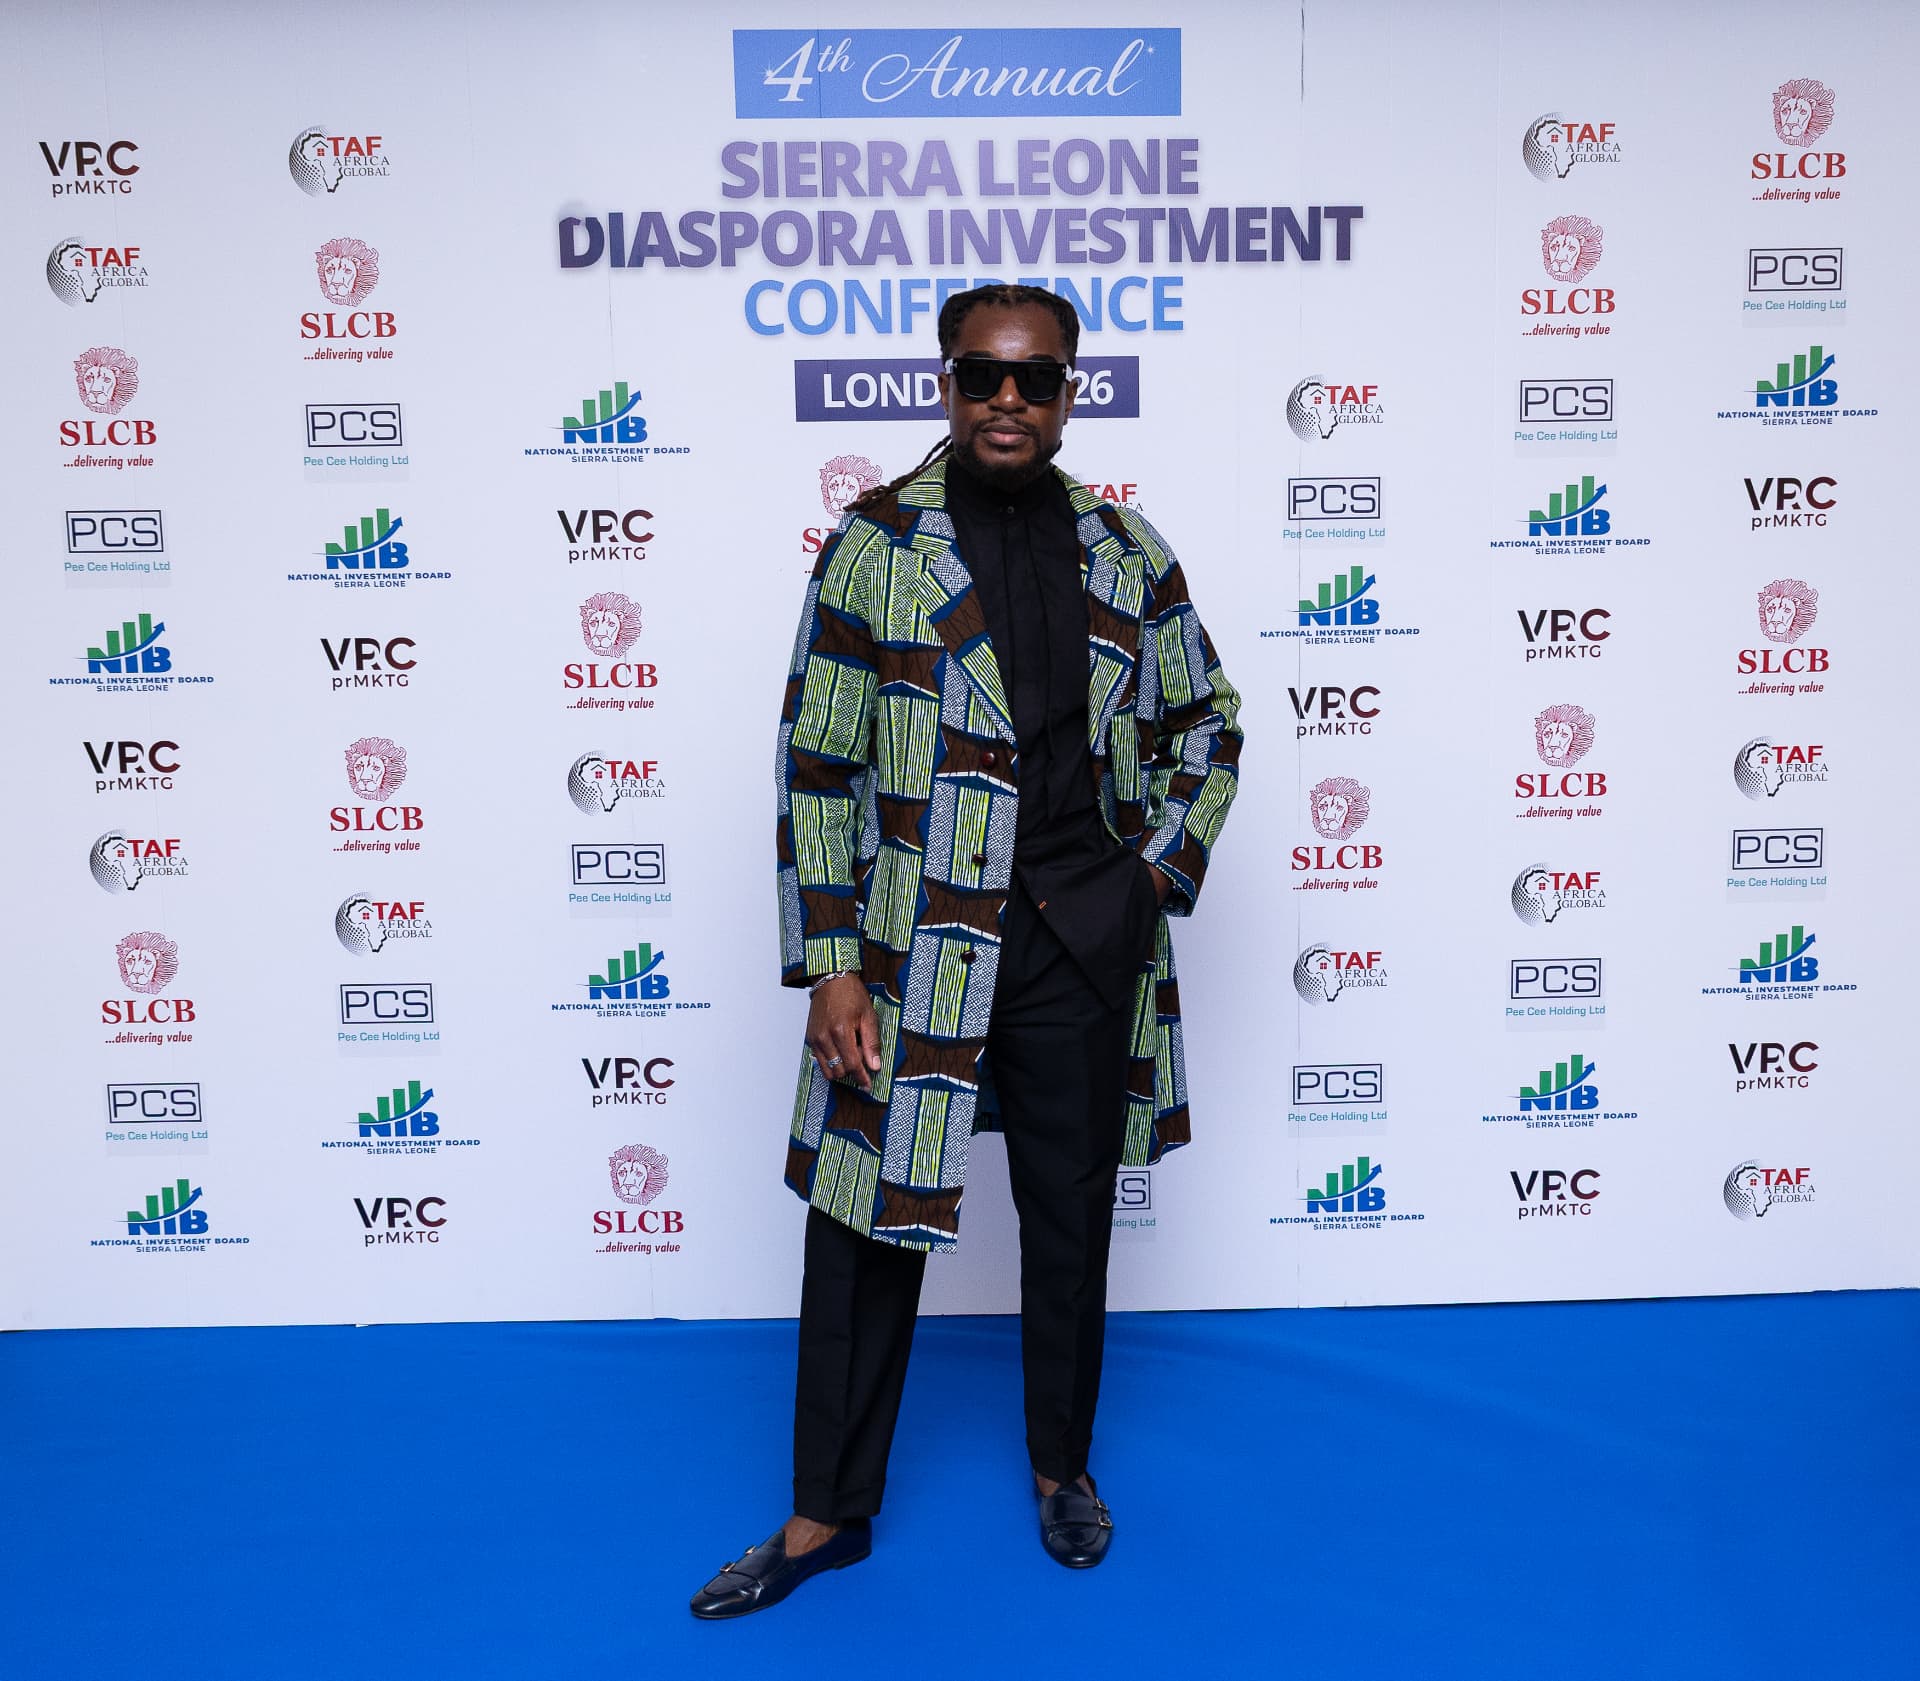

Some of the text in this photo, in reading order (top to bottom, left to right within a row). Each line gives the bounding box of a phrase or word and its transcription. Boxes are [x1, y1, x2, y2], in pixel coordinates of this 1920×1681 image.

[763, 35, 1144, 103] 4th Annual
[1563, 123, 1615, 142] TAF
[327, 137, 381, 156] TAF
[1566, 142, 1621, 153] AFRICA
[39, 141, 139, 176] VRC
[333, 155, 389, 167] AFRICA
[1576, 154, 1620, 163] GLOBAL
[1752, 153, 1846, 179] SLCB
[344, 168, 390, 177] GLOBAL
[720, 138, 1199, 198] SIERRA LEONE
[52, 180, 131, 198] prMKTG
[1752, 187, 1840, 203] ...delivering value
[558, 206, 1363, 268] DIASPORA INVESTMENT
[84, 247, 139, 266] TAF
[91, 266, 148, 277] AFRICA
[1753, 255, 1837, 286] PCS
[102, 278, 148, 287] GLOBAL
[744, 276, 1184, 336] CONFNCE
[1522, 289, 1615, 315] SLCB
[1743, 300, 1846, 311] Pee Cee Holding Ltd
[301, 312, 396, 339] SLCB
[1522, 322, 1610, 338] ...delivering value
[304, 347, 393, 363] ...delivering value
[1325, 386, 1377, 404] TAF
[1525, 386, 1608, 416] PCS
[1756, 379, 1839, 407] NIB
[1329, 404, 1383, 414] AFRICA
[1773, 410, 1839, 418] INVESTMENT
[1843, 409, 1878, 417] BOARD
[309, 408, 399, 443] PCS
[1339, 415, 1383, 424] GLOBAL
[1763, 418, 1832, 426] SIERRA LEONE
[60, 420, 156, 446] SLCB
[562, 416, 648, 443] NIB
[572, 455, 643, 463] SIERRA LEONE
[582, 447, 650, 455] INVESTMENT
[64, 454, 153, 470] ...delivering value
[304, 456, 408, 467] Pee Cee Holding Ltd
[1293, 484, 1376, 514] PCS
[1744, 477, 1837, 510] VRC
[69, 515, 160, 548] PCS
[557, 510, 654, 543] VRC
[1528, 511, 1610, 536] NIB
[1752, 514, 1826, 531] prMKTG
[1491, 538, 1650, 548] NATIONAL INVESTMENT BOARD
[1536, 547, 1605, 555] SIERRA LEONE
[325, 542, 409, 569] NIB
[569, 547, 645, 563] prMKTG
[64, 561, 170, 573] Pee Cee Holding Ltd
[288, 573, 341, 581] NATIONAL
[345, 572, 412, 580] INVESTMENT
[334, 580, 406, 589] SIERRA LEONE
[1299, 599, 1380, 626] NIB
[1517, 609, 1611, 642] VRC
[87, 647, 171, 673] NIB
[320, 637, 417, 671] VRC
[1527, 645, 1600, 662] prMKTG
[1738, 649, 1829, 674] SLCB
[332, 674, 408, 691] prMKTG
[564, 663, 658, 688] SLCB
[1738, 681, 1823, 696] ...delivering value
[567, 697, 654, 711] ...delivering value
[1288, 686, 1380, 719] VRC
[1297, 722, 1371, 739] prMKTG
[83, 741, 180, 774] VRC
[1772, 746, 1823, 763] TAF
[605, 761, 657, 778] TAF
[1776, 763, 1828, 773] AFRICA
[96, 777, 172, 793] prMKTG
[1516, 773, 1607, 798] SLCB
[1784, 774, 1827, 783] GLOBAL
[330, 807, 423, 831] SLCB
[1516, 805, 1601, 820] ...delivering value
[127, 839, 180, 857] TAF
[1737, 835, 1818, 864] PCS
[577, 850, 663, 879] PCS
[1292, 845, 1382, 870] SLCB
[1549, 872, 1600, 889] TAF
[372, 902, 424, 919] TAF
[378, 918, 432, 929] AFRICA
[388, 930, 432, 939] GLOBAL
[1330, 952, 1381, 969] TAF
[1515, 965, 1596, 993] PCS
[1740, 958, 1819, 983] NIB
[589, 974, 670, 1000] NIB
[102, 999, 195, 1024] SLCB
[345, 990, 428, 1018] PCS
[1506, 1005, 1605, 1017] Pee Cee Holding Ltd
[105, 1031, 192, 1045] ...delivering value
[1728, 1042, 1819, 1074] VRC
[582, 1058, 675, 1089] VRC
[1298, 1071, 1377, 1099] PCS
[1737, 1076, 1808, 1092] prMKTG
[110, 1090, 196, 1119] PCS
[593, 1092, 666, 1108] prMKTG
[1520, 1087, 1598, 1112] NIB
[359, 1112, 440, 1137] NIB
[1510, 1169, 1600, 1201] VRC
[1760, 1168, 1810, 1185] TAF
[1764, 1184, 1815, 1194] AFRICA
[1307, 1188, 1386, 1212] NIB
[1773, 1195, 1814, 1204] GLOBAL
[354, 1197, 447, 1228] VRC
[1324, 1215, 1387, 1223] INVESTMENT
[1519, 1203, 1591, 1220] prMKTG
[127, 1210, 209, 1235] NIB
[594, 1210, 683, 1234] SLCB
[1112, 1217, 1156, 1229] lding Ltd
[1314, 1222, 1381, 1231] SIERRA LEONE
[365, 1231, 439, 1247] prMKTG
